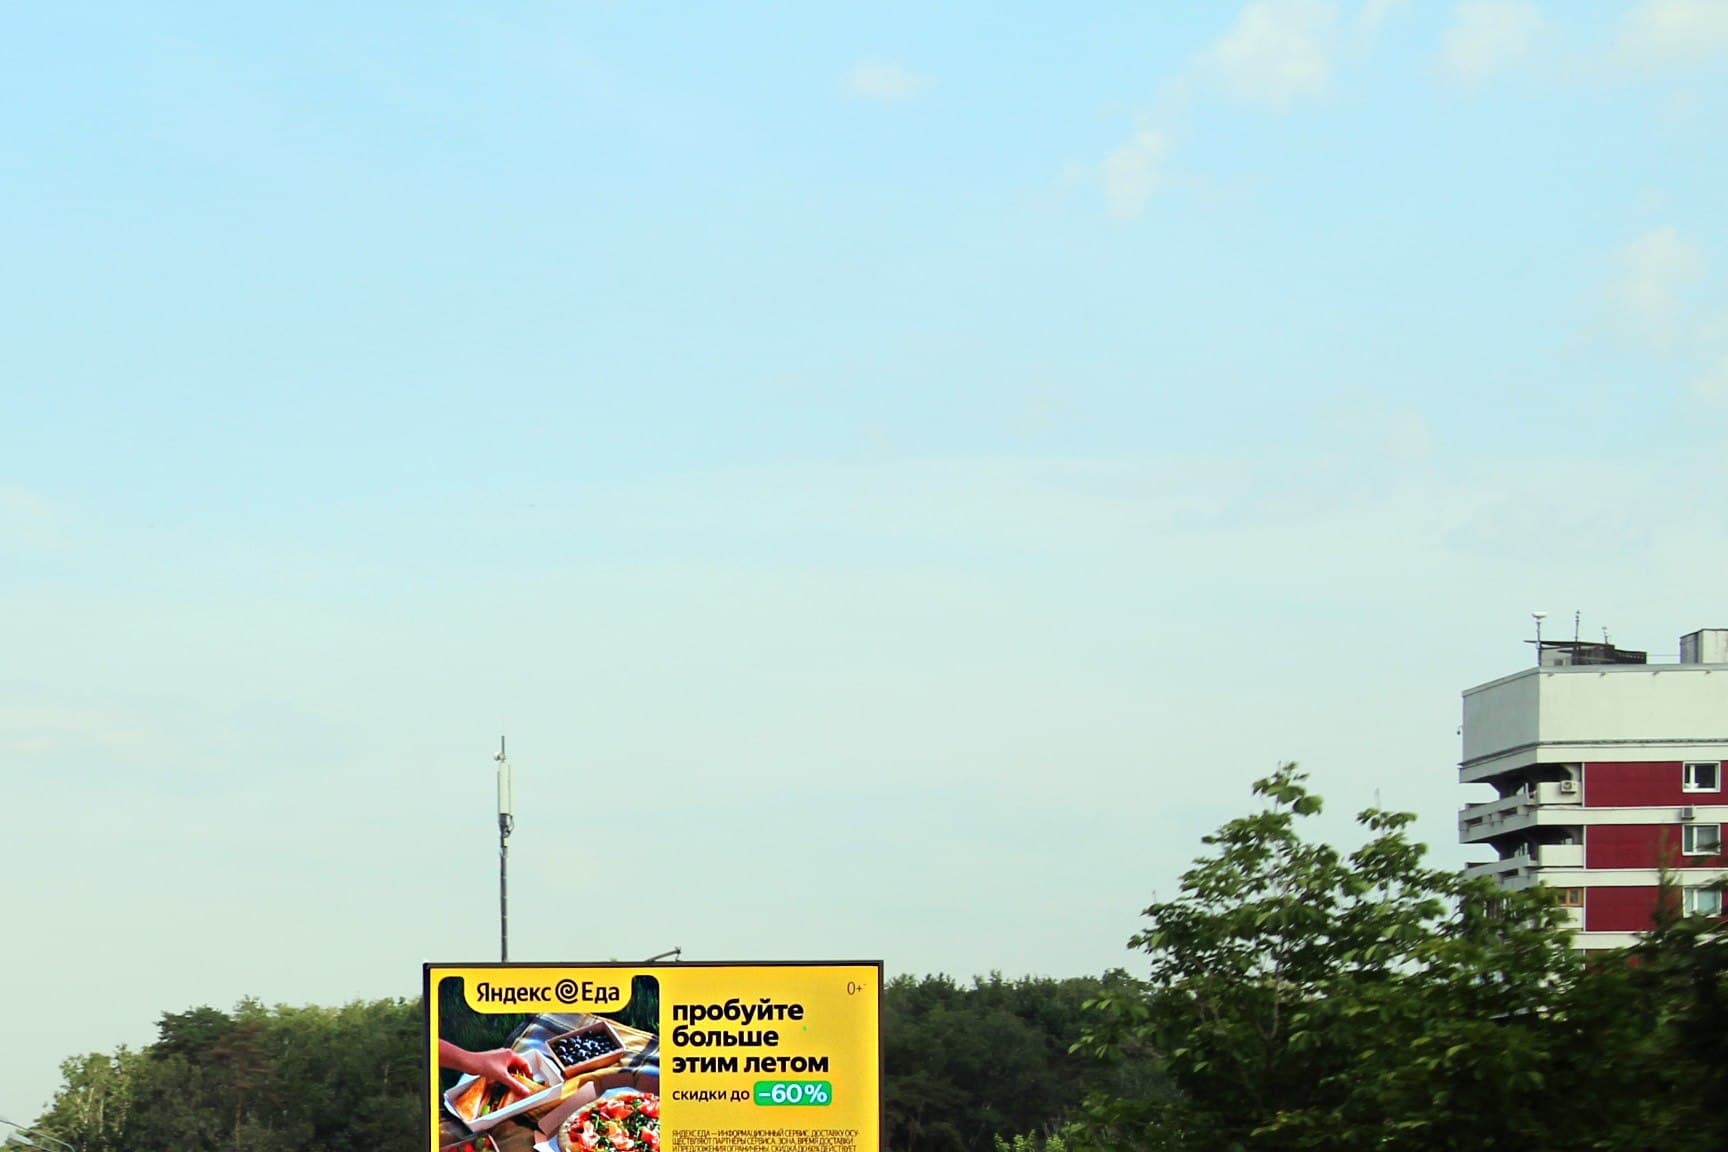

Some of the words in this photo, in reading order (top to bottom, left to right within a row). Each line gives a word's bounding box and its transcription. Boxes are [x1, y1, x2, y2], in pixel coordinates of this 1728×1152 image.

[477, 982, 551, 1004] Яндекс
[582, 981, 620, 1003] Еда
[672, 998, 804, 1026] пробуйте
[672, 1025, 779, 1047] больше
[672, 1056, 738, 1073] этим
[744, 1056, 829, 1073] летом
[672, 1090, 727, 1102] скидки
[730, 1090, 750, 1102] до
